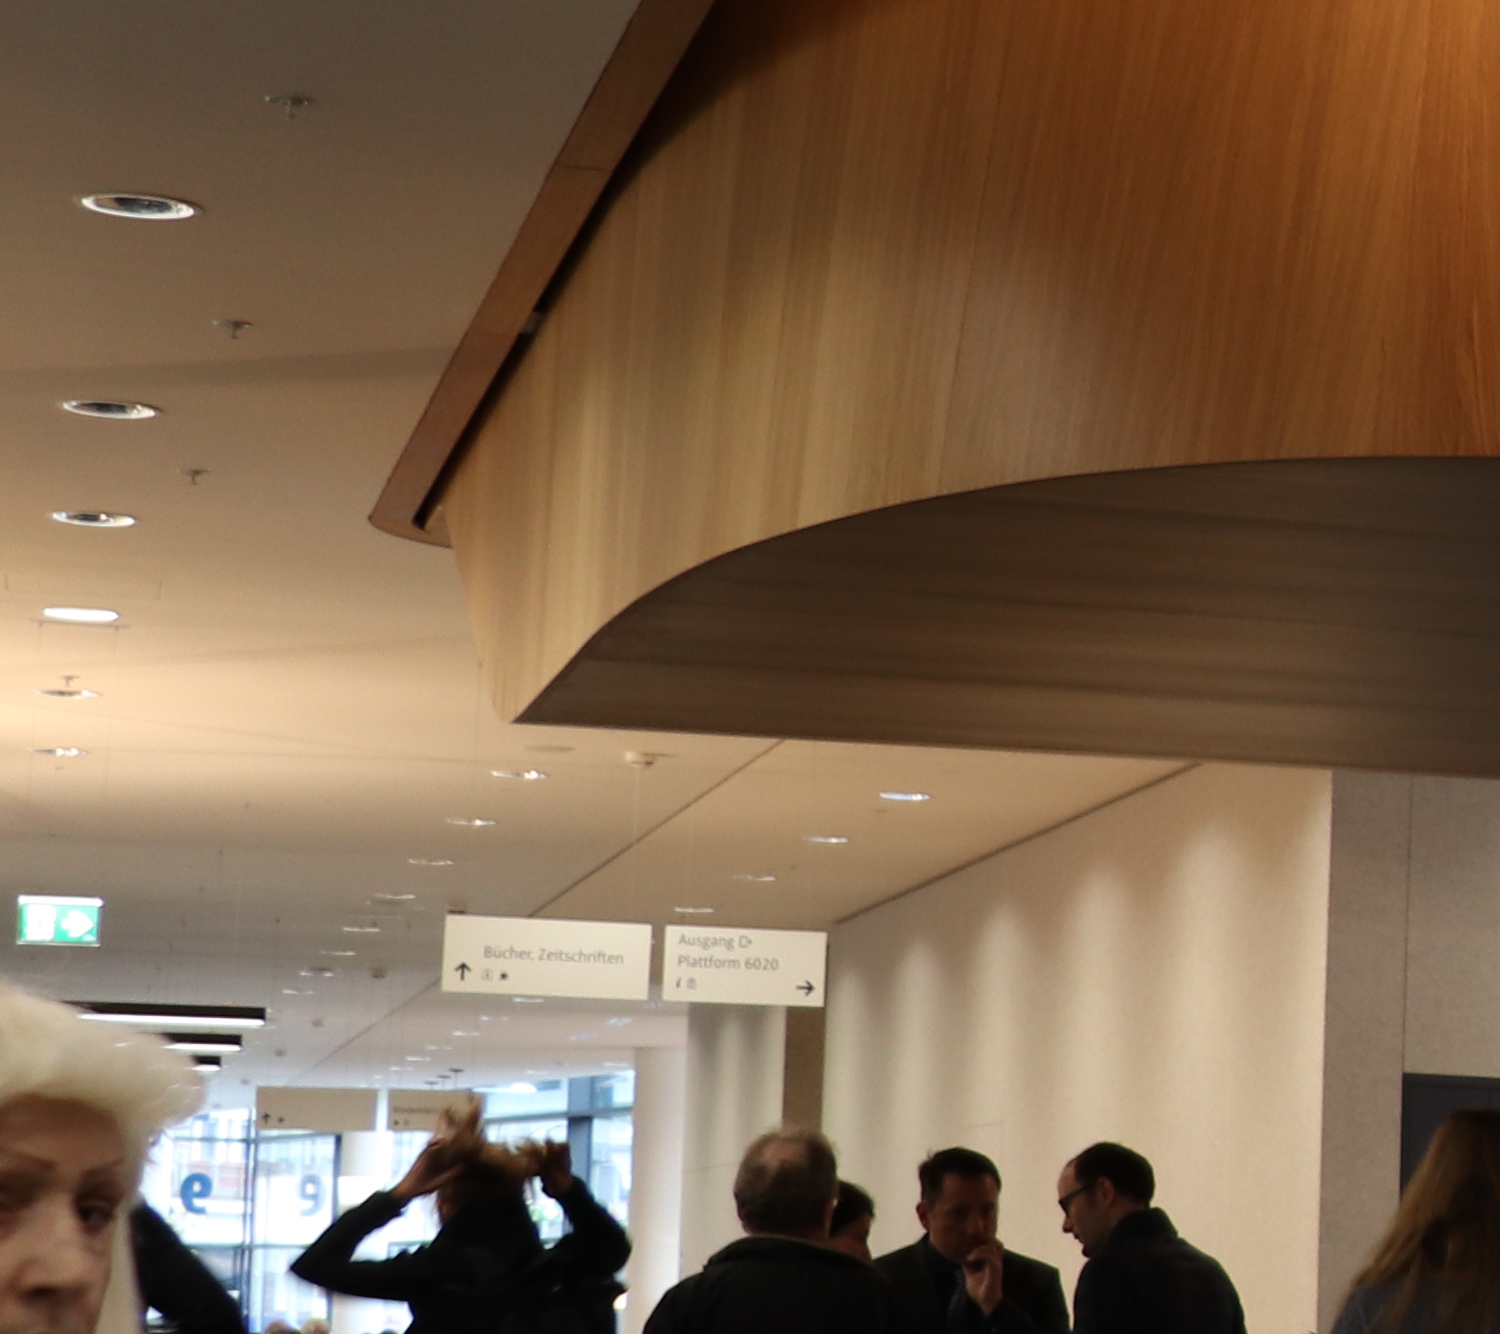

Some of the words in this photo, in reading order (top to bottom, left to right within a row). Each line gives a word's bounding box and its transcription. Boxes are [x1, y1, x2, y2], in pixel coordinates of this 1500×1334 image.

[678, 933, 735, 952] Ausgang
[484, 944, 534, 962] Bücher,
[538, 948, 625, 965] Zeitschriften
[677, 955, 741, 970] Plattform
[744, 957, 779, 972] 6020
